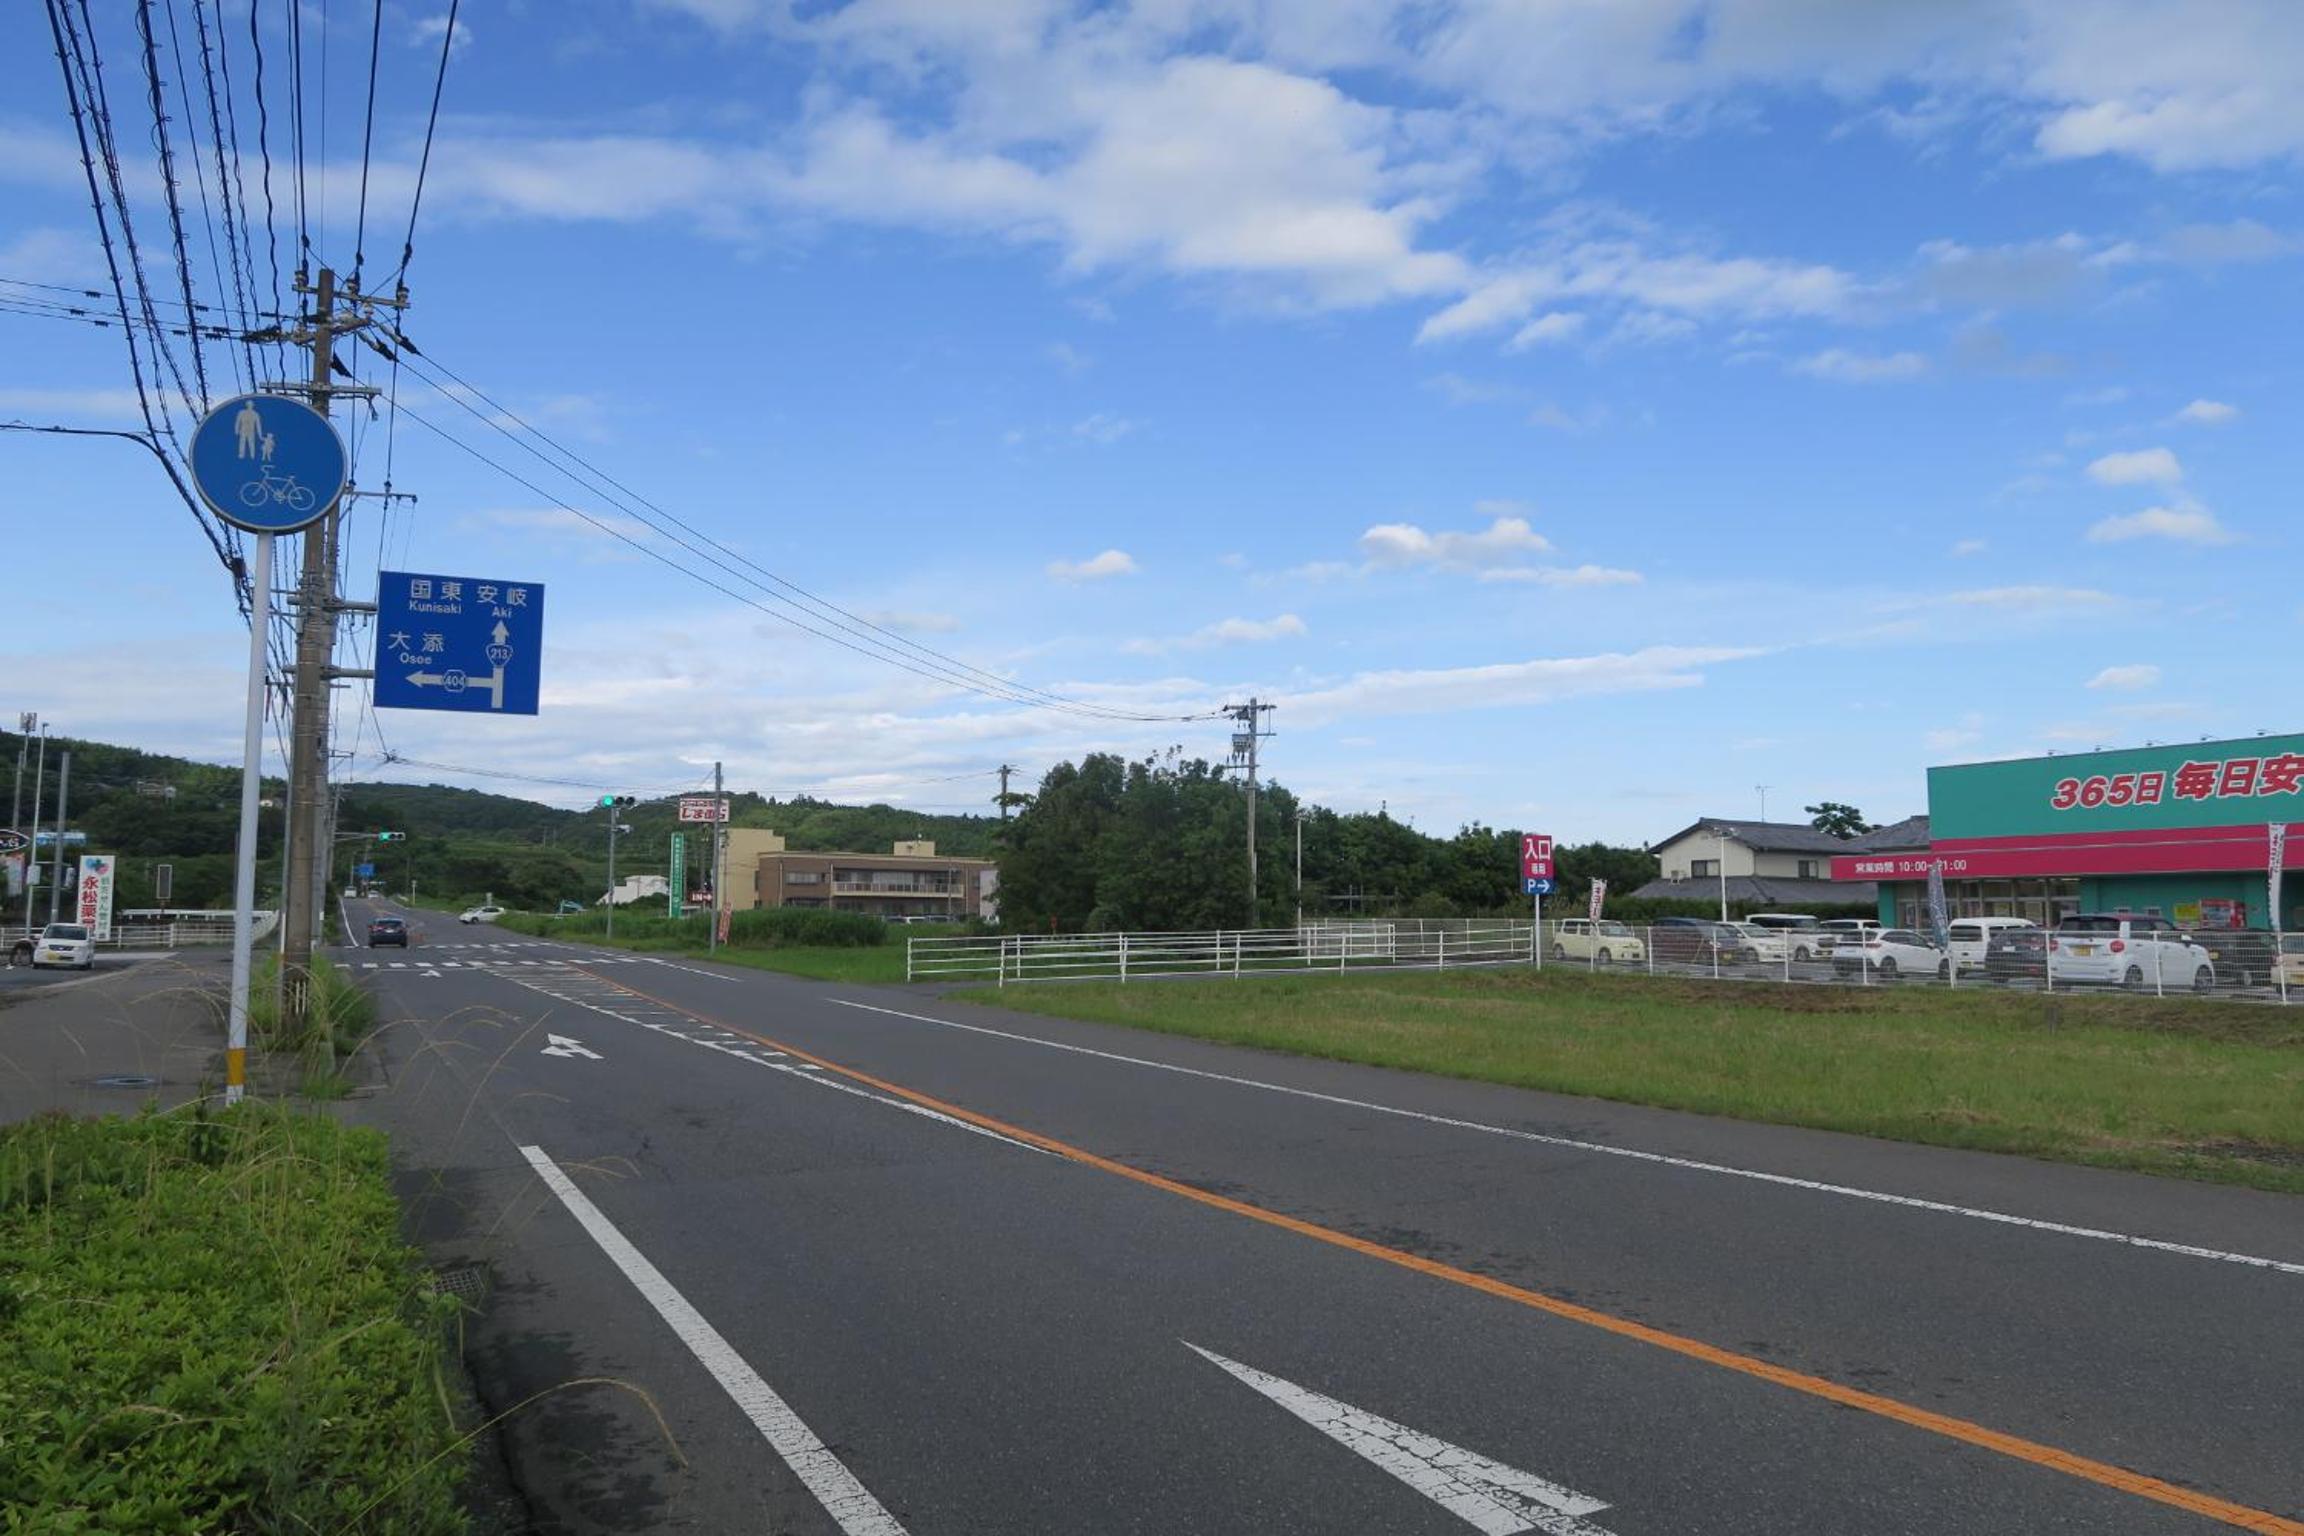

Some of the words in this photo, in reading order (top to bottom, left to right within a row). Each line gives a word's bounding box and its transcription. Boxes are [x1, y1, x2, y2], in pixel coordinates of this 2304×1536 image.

[410, 578, 463, 601] 国東
[476, 584, 528, 607] 安岐
[409, 600, 462, 614] Kunisaki
[491, 607, 512, 618] Aki
[388, 631, 445, 652] 大添
[400, 652, 432, 665] Osoe
[490, 648, 508, 659] 213
[445, 674, 465, 686] 404
[2052, 771, 2166, 810] 365日
[1525, 838, 1551, 860] 入口
[1527, 878, 1537, 893] P
